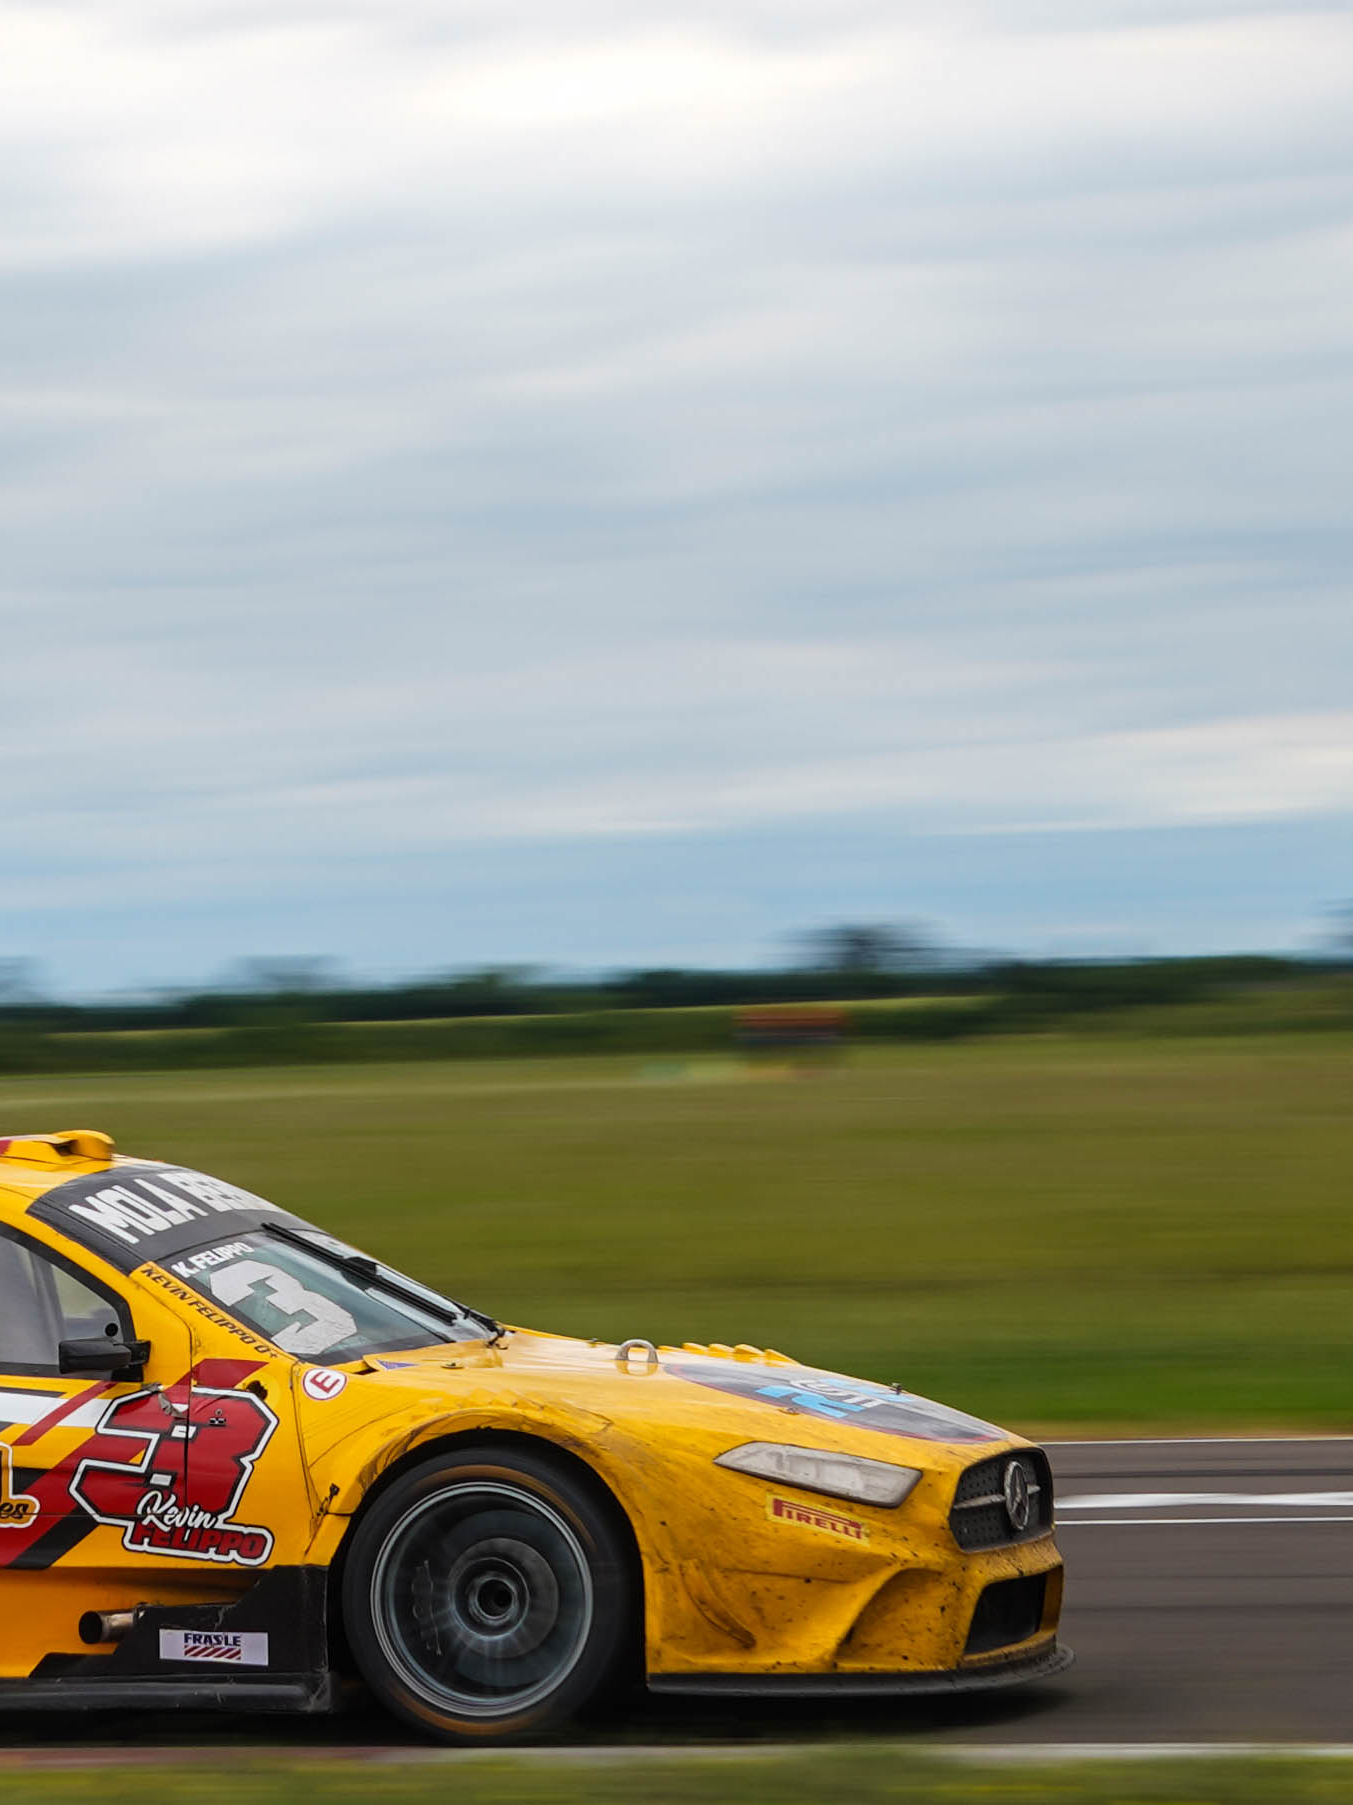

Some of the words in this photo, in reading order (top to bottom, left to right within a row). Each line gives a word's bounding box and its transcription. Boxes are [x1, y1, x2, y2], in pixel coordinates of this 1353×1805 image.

[68, 1178, 209, 1245] MOLA
[140, 1267, 192, 1301] KEVIN
[187, 1300, 257, 1345] FELIPPO
[209, 1260, 357, 1356] 3
[310, 1370, 340, 1394] E
[68, 1383, 280, 1529] 3
[136, 1489, 217, 1533] Kevin
[772, 1497, 863, 1540] PIRELLI
[127, 1521, 270, 1561] FELIPPO
